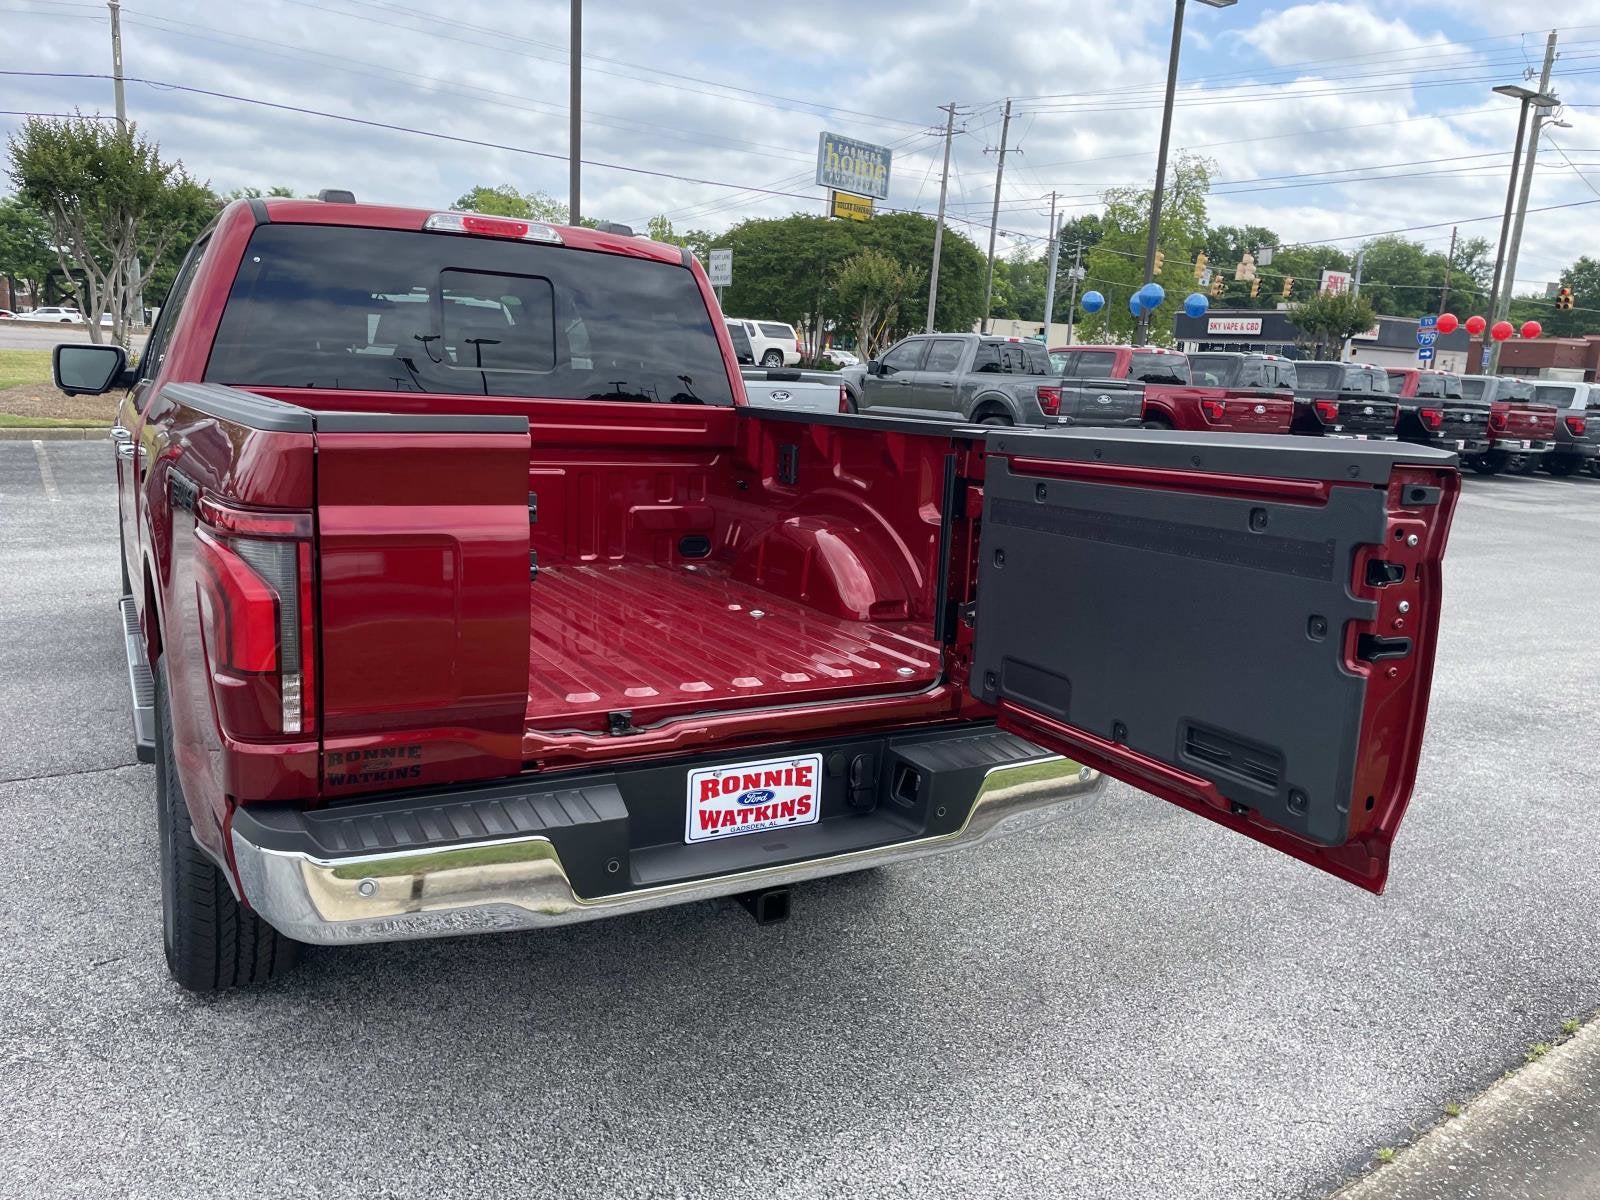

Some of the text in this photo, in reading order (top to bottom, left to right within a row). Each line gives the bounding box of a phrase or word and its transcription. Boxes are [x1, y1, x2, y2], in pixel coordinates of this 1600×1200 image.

[838, 144, 882, 161] FARMERS
[825, 143, 887, 180] home
[1328, 275, 1345, 289] SKY
[1209, 322, 1259, 331] SKY VAPE & CBD
[1424, 318, 1433, 326] TO
[1420, 333, 1436, 344] 759
[328, 745, 422, 766] RONNIE
[328, 764, 421, 785] WATKINS
[699, 765, 813, 803] RONNIE
[743, 791, 768, 804] Ford
[699, 794, 812, 831] WATKINS
[730, 820, 778, 833] GADSDEN, AL
